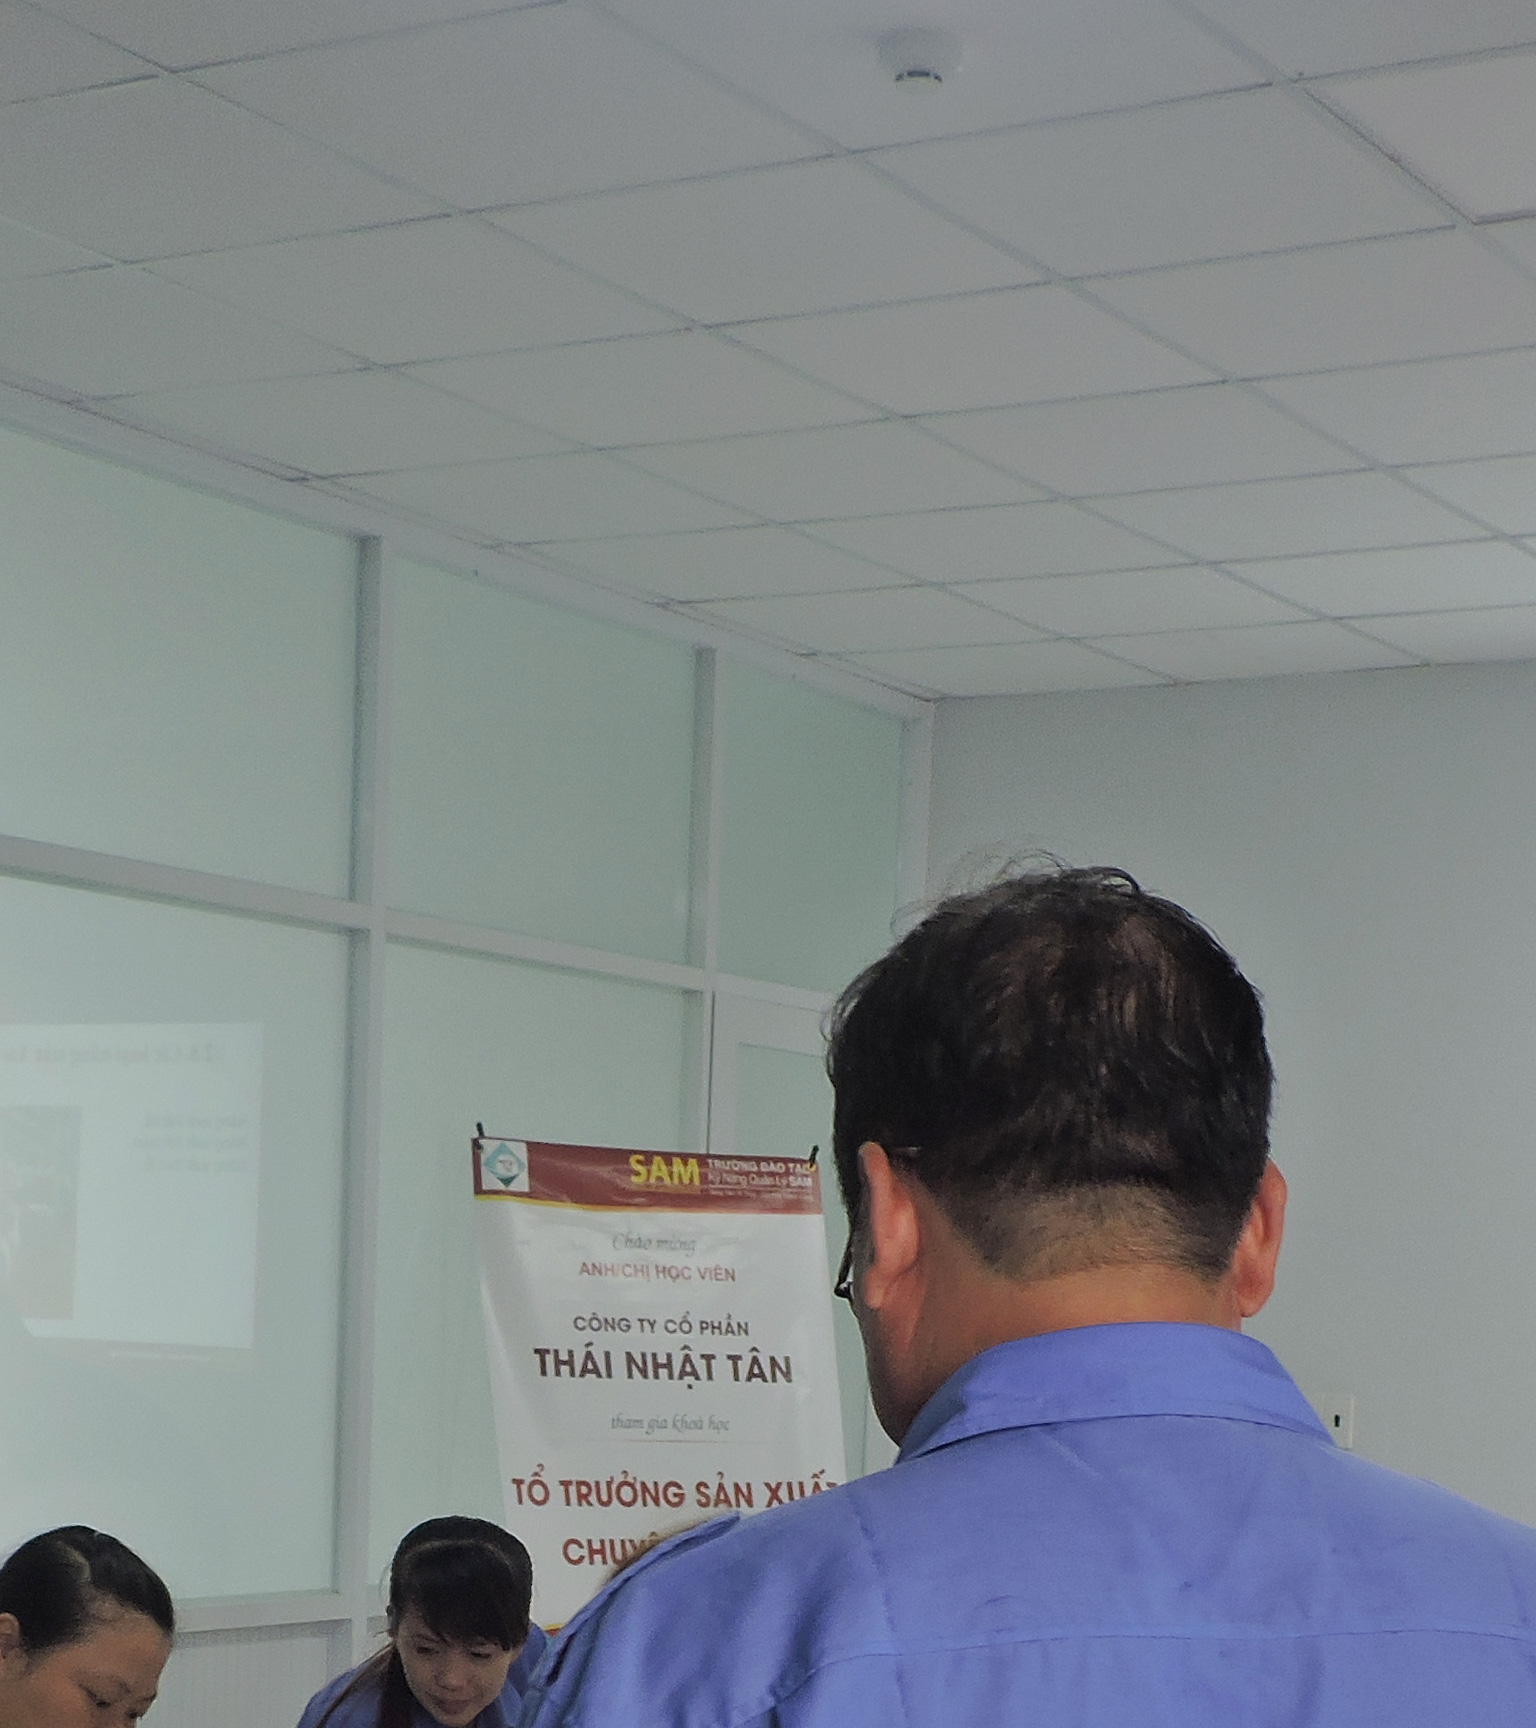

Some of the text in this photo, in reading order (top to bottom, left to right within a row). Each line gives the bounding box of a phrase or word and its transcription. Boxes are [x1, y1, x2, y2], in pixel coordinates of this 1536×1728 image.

[629, 1153, 701, 1187] SAM
[655, 1263, 693, 1283] HỌC
[697, 1264, 737, 1283] VIÊN
[573, 1310, 751, 1337] CÔNG TY CỔ PHẦN
[533, 1341, 793, 1390] THÁI NHẬT TÂN
[511, 1462, 840, 1509] TỔ TRƯỞNG SẢN XUẤ
